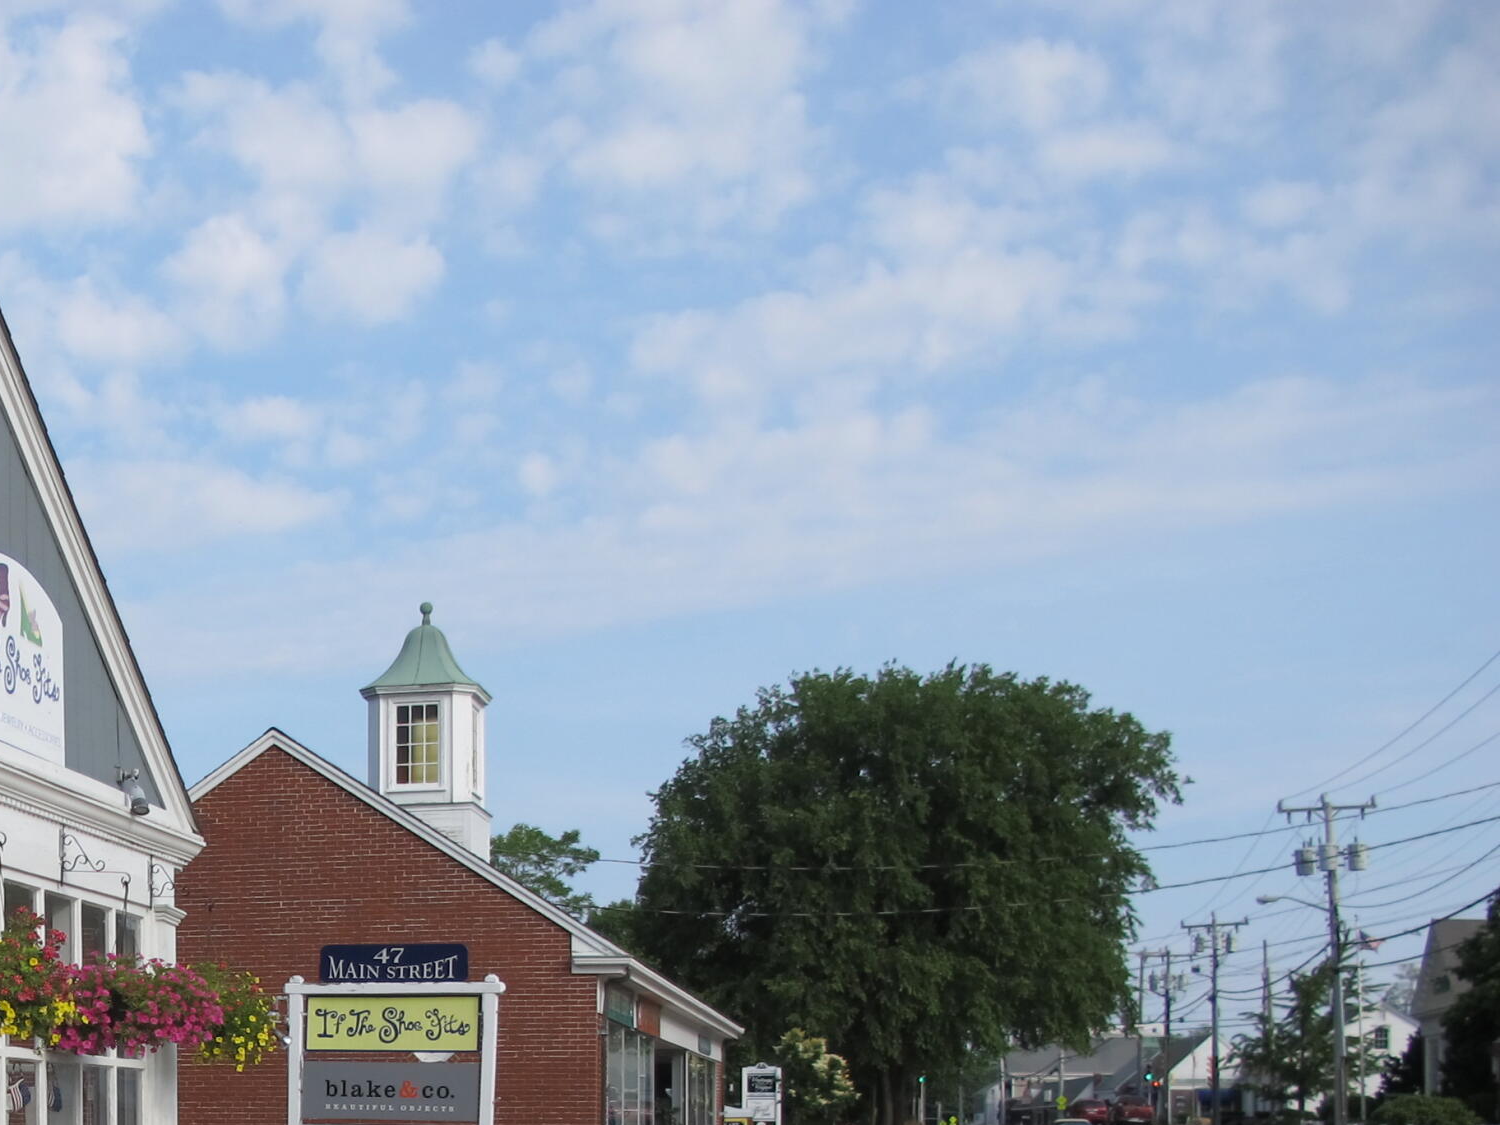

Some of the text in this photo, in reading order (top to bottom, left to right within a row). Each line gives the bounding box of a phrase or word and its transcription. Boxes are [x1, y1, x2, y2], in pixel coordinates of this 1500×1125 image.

[4, 635, 31, 694] Shoe
[328, 955, 459, 979] MAIN STREET
[373, 948, 405, 964] 47
[315, 1007, 471, 1043] If The Shoe Fits
[325, 1103, 394, 1112] BEAUTIFUL
